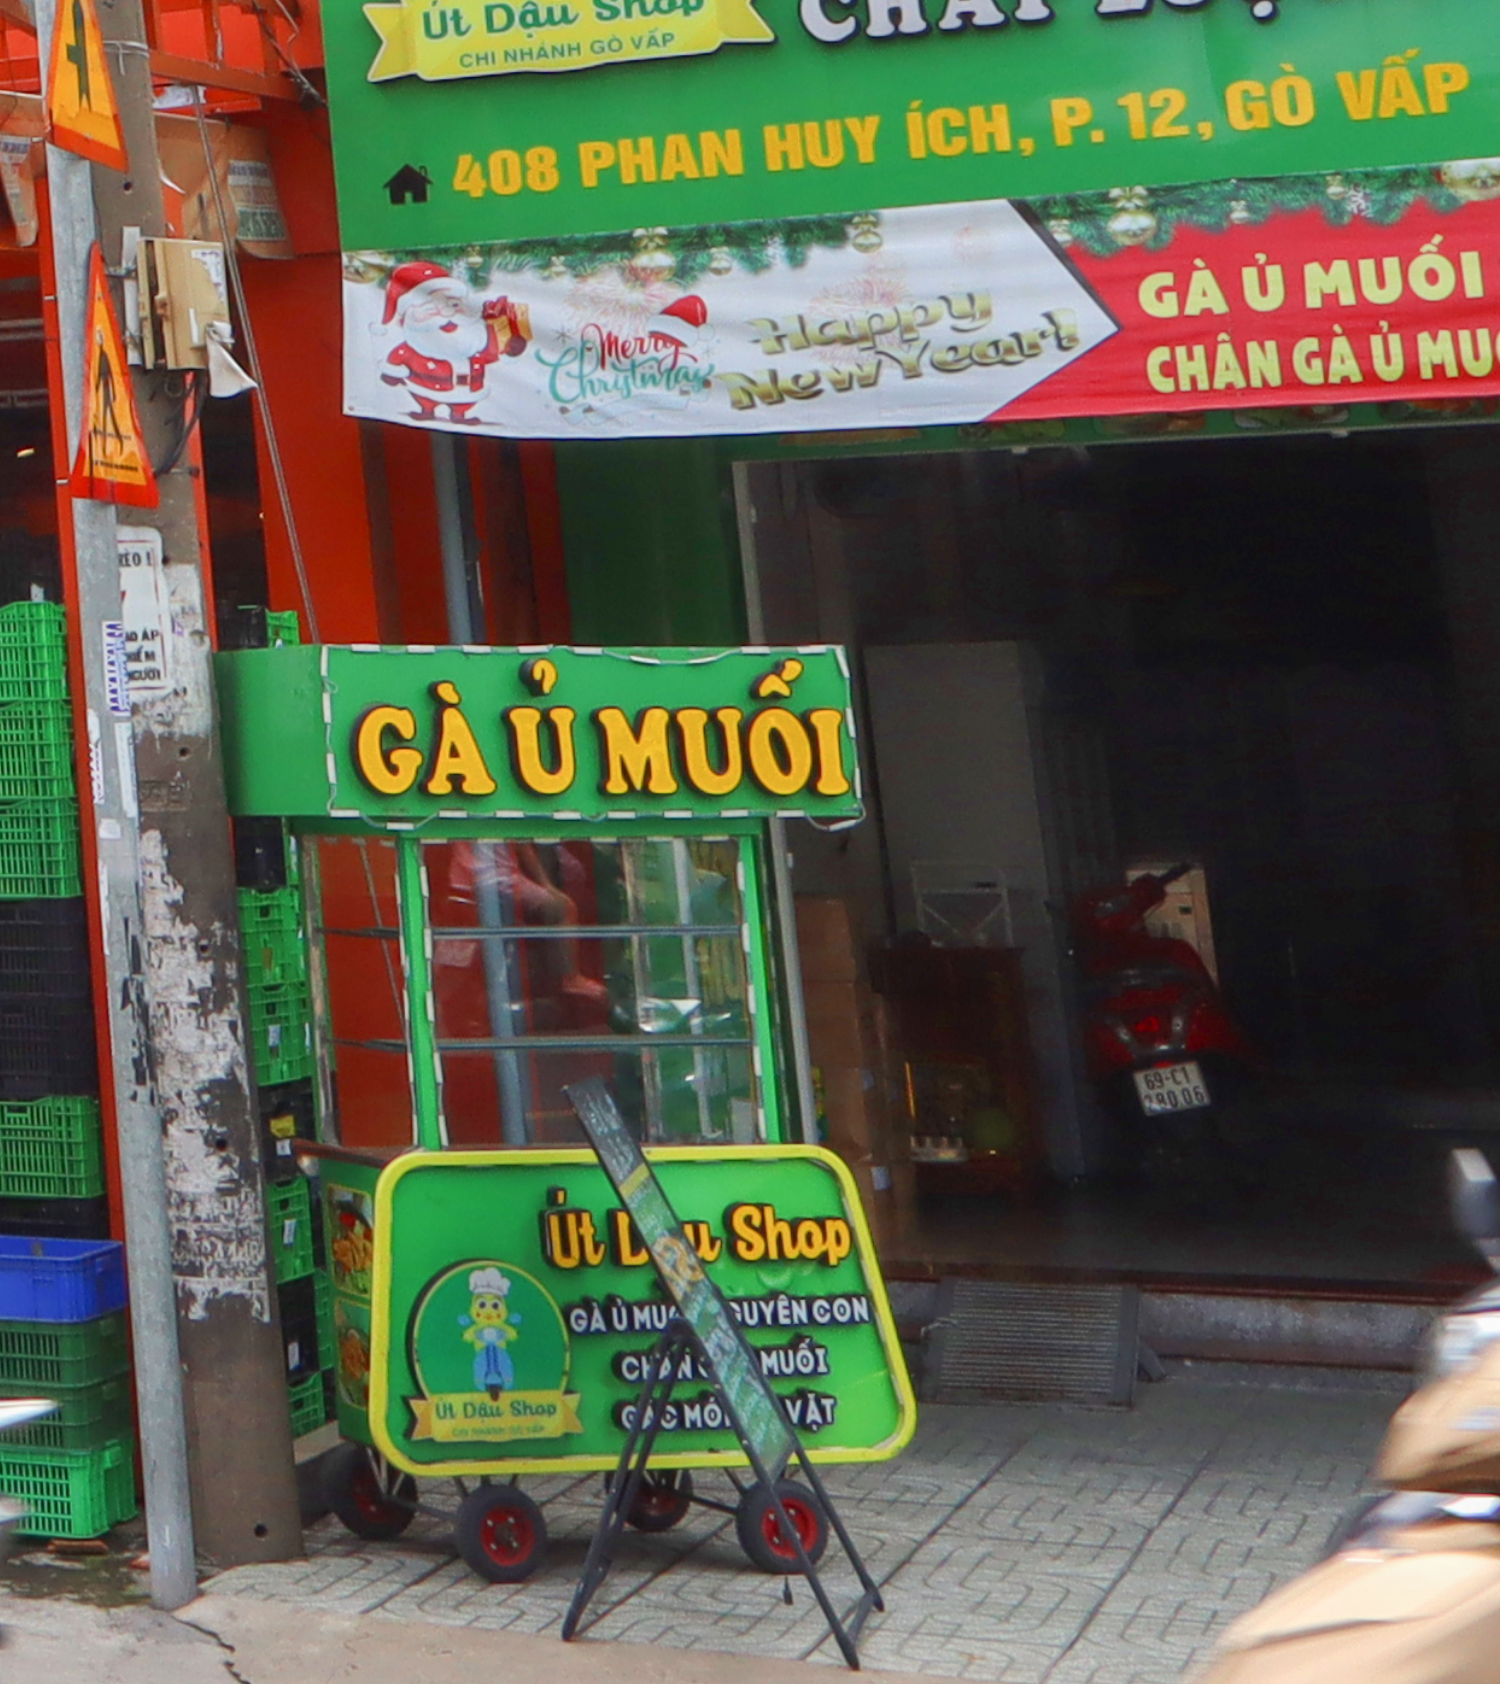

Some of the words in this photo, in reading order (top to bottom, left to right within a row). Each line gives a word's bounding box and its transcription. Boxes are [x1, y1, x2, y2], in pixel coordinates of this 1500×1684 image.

[422, 0, 471, 40] Út
[485, 2, 579, 39] Dậu
[459, 50, 497, 69] CHI
[503, 39, 582, 64] NHÁNH
[590, 31, 623, 55] GÒ
[630, 28, 676, 50] VẤP
[452, 146, 561, 201] 408
[578, 129, 744, 192] PHAN
[764, 115, 880, 172] HUY
[907, 100, 1035, 161] ÍCH,
[1051, 98, 1104, 146] P.
[1117, 87, 1214, 141] 12,
[1226, 64, 1316, 132] GÒ
[1336, 49, 1471, 120] VẤP
[1138, 258, 1230, 318] GÀ
[1241, 253, 1286, 312] Ủ
[1304, 234, 1484, 309] MUỐI
[596, 323, 683, 372] Merry
[748, 290, 991, 357] Happy
[536, 344, 715, 405] Christmas
[1146, 332, 1282, 394] CHÂN
[1292, 324, 1363, 385] GÀ
[1369, 320, 1405, 382] Ủ
[353, 681, 496, 796] GÀ
[504, 660, 577, 795] Ủ
[593, 659, 851, 796] MUỐI
[546, 1189, 606, 1269] Út
[726, 1204, 851, 1266] Shop
[570, 1303, 606, 1334] GÀ
[611, 1299, 629, 1332] Ủ
[812, 1296, 870, 1325] CON
[760, 1339, 829, 1374] MUỐI
[510, 1401, 557, 1417] Shop
